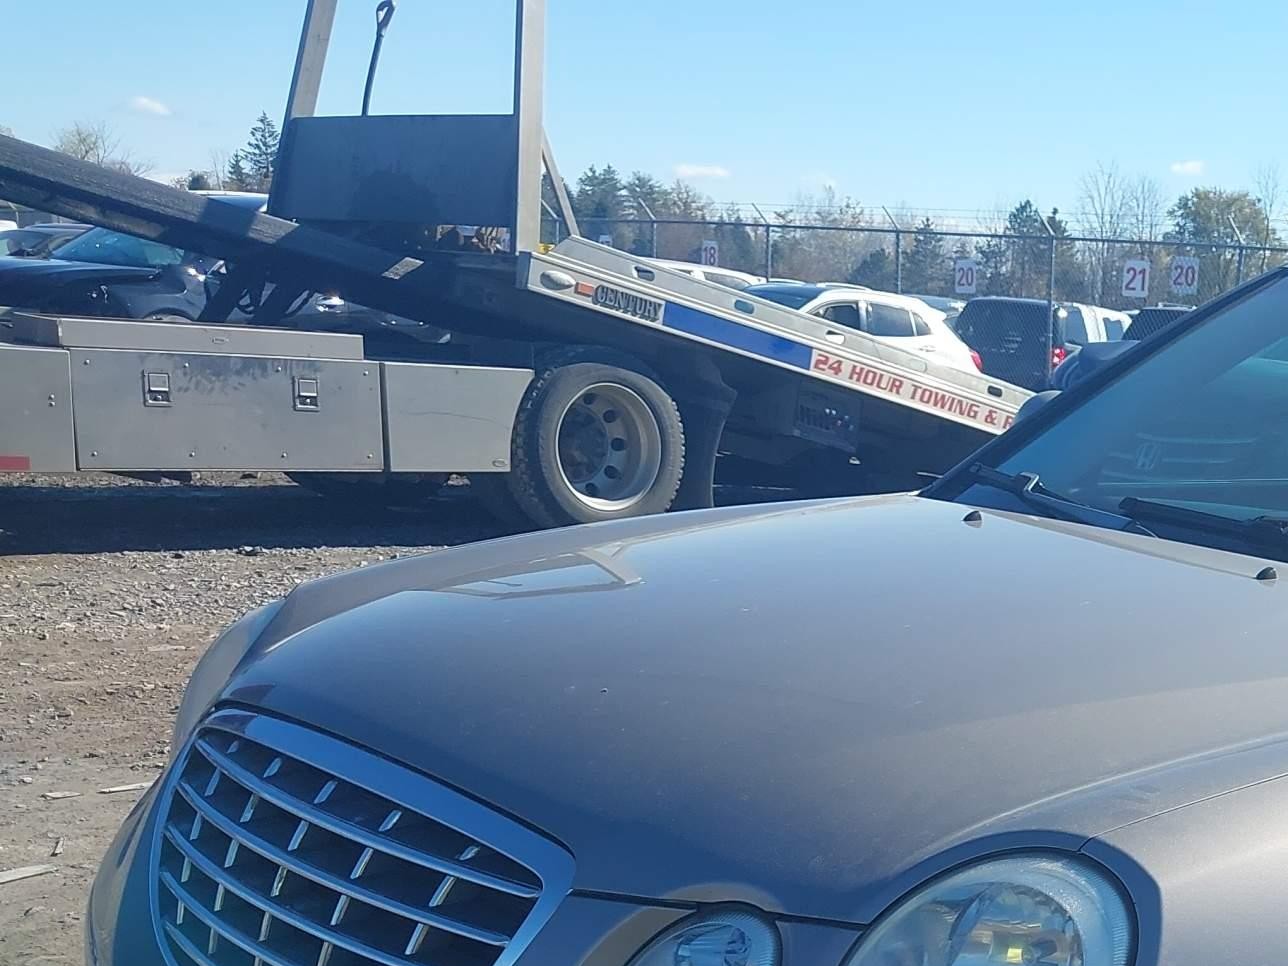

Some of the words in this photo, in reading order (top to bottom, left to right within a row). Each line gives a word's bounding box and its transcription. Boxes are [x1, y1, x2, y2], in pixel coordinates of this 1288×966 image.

[703, 246, 716, 266] 18
[957, 267, 974, 287] 20
[1124, 267, 1146, 292] 21
[1173, 265, 1195, 287] 20
[595, 284, 662, 319] CENTURY
[813, 353, 843, 376] 24
[849, 364, 904, 396] HOUR
[909, 384, 981, 421] TOWING
[984, 409, 1000, 427] &
